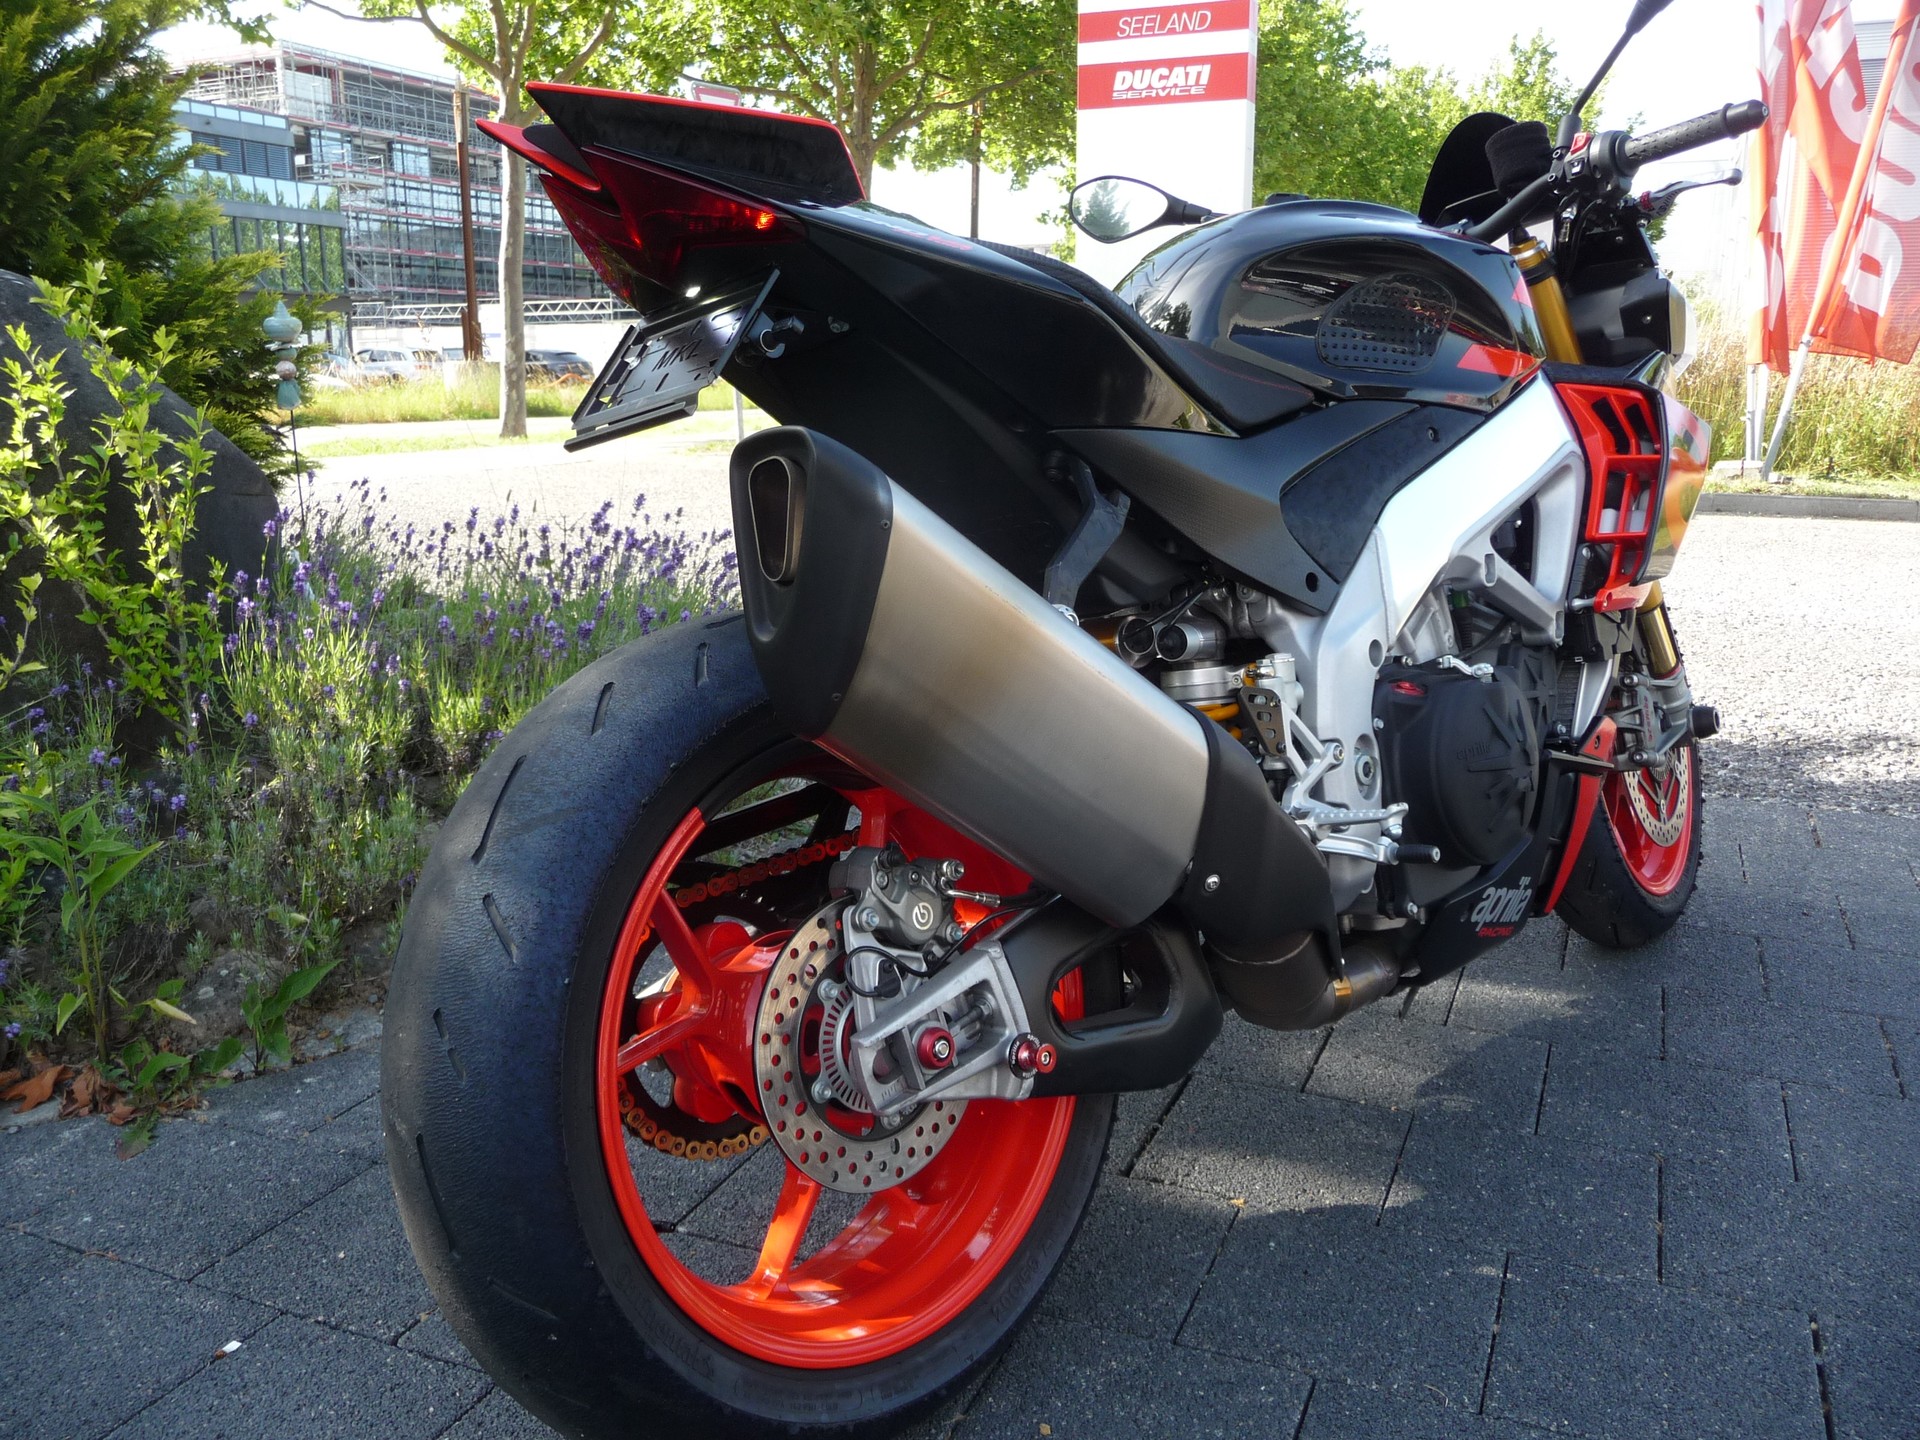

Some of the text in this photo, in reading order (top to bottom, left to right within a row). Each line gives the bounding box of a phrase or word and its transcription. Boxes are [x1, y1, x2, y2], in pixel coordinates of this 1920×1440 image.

[1116, 10, 1211, 38] SEELAND
[1113, 64, 1211, 91] DUCATI
[1112, 86, 1206, 100] SERVICE
[1470, 876, 1532, 932] aprilia
